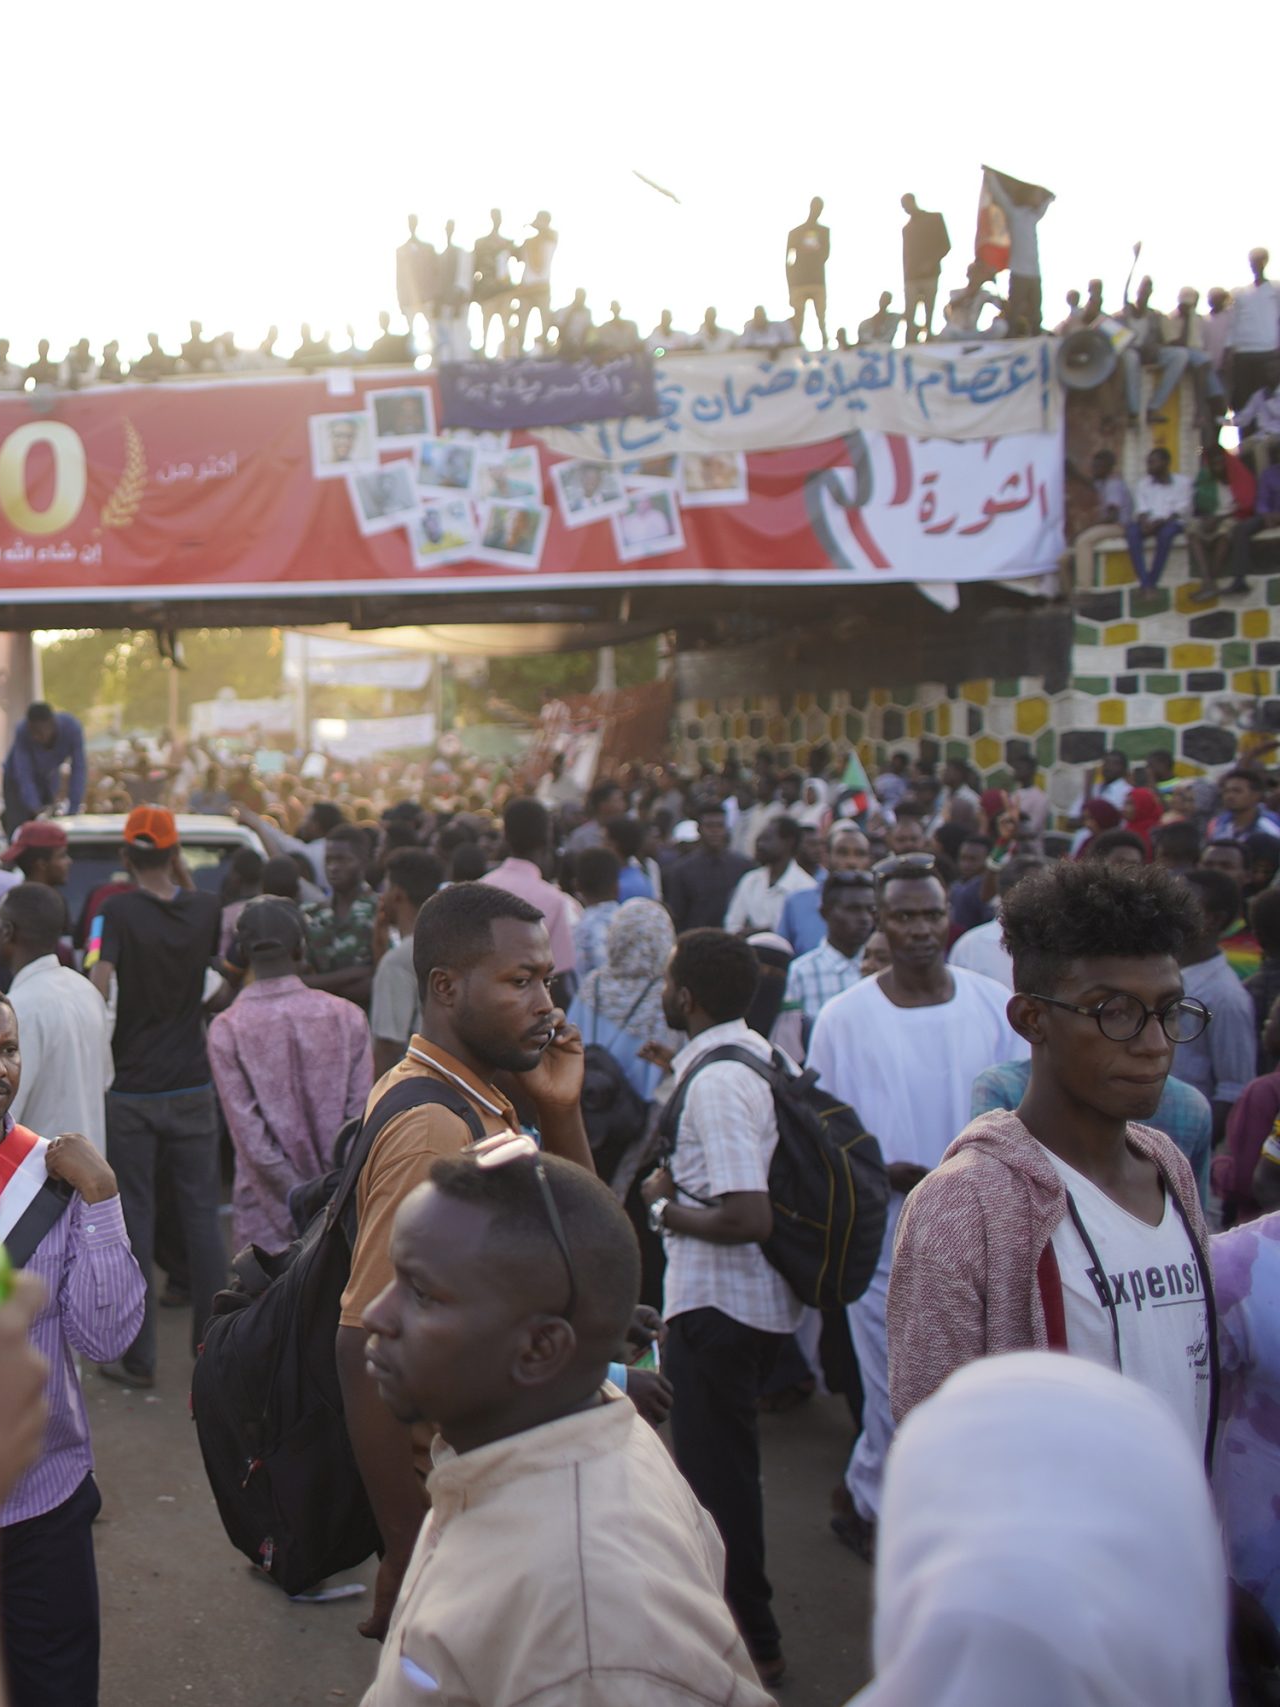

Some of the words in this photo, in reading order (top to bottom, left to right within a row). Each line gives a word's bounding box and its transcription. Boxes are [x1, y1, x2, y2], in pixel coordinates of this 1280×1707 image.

[691, 360, 799, 423] ضمان
[155, 461, 194, 485] من
[920, 461, 1048, 536] الثورة
[4, 538, 34, 561] الله
[36, 541, 77, 562] شاء
